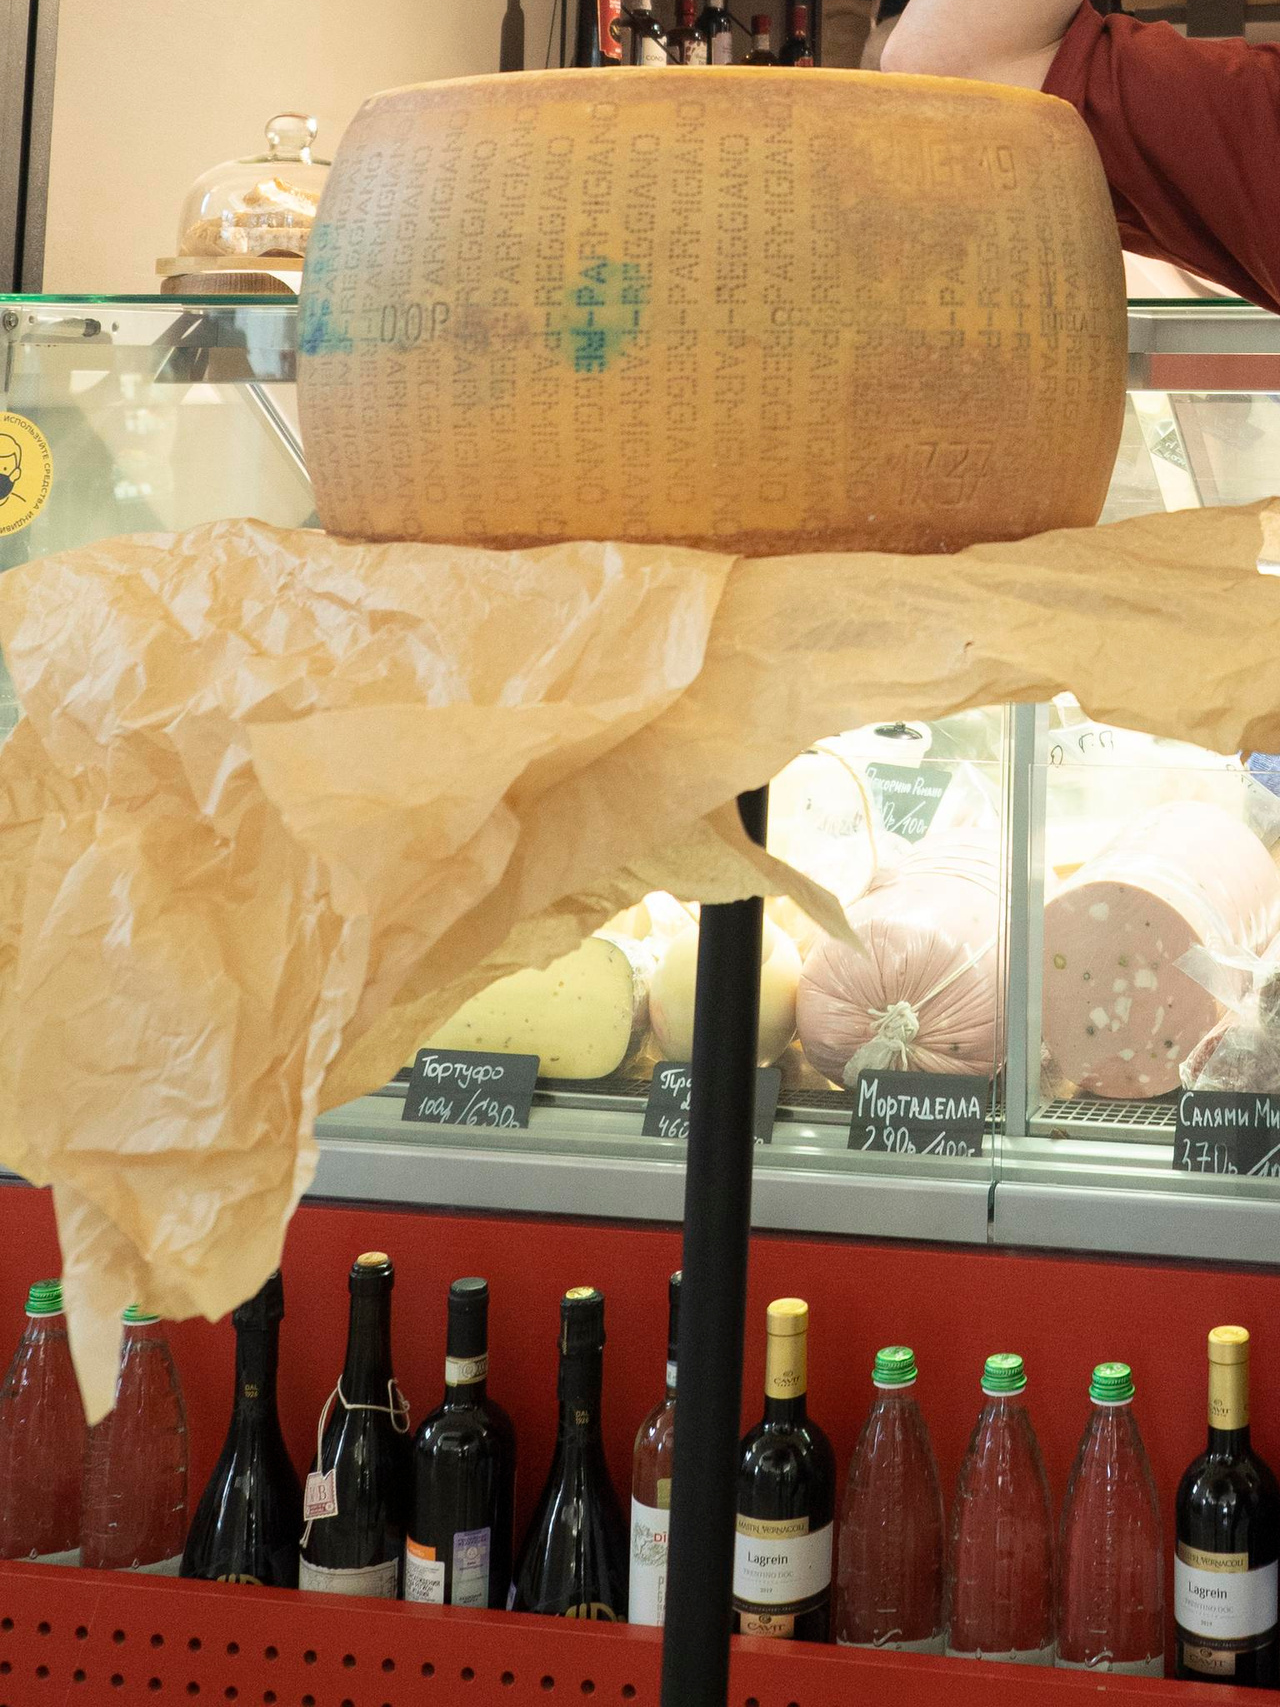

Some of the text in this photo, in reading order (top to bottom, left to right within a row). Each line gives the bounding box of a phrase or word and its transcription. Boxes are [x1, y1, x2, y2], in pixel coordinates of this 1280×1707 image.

[3, 415, 51, 510] ИСПОЛЬЗУЙТЕ СРЕДСТВА
[747, 1551, 789, 1567] Lagrein
[1188, 1581, 1228, 1600] Lagrein
